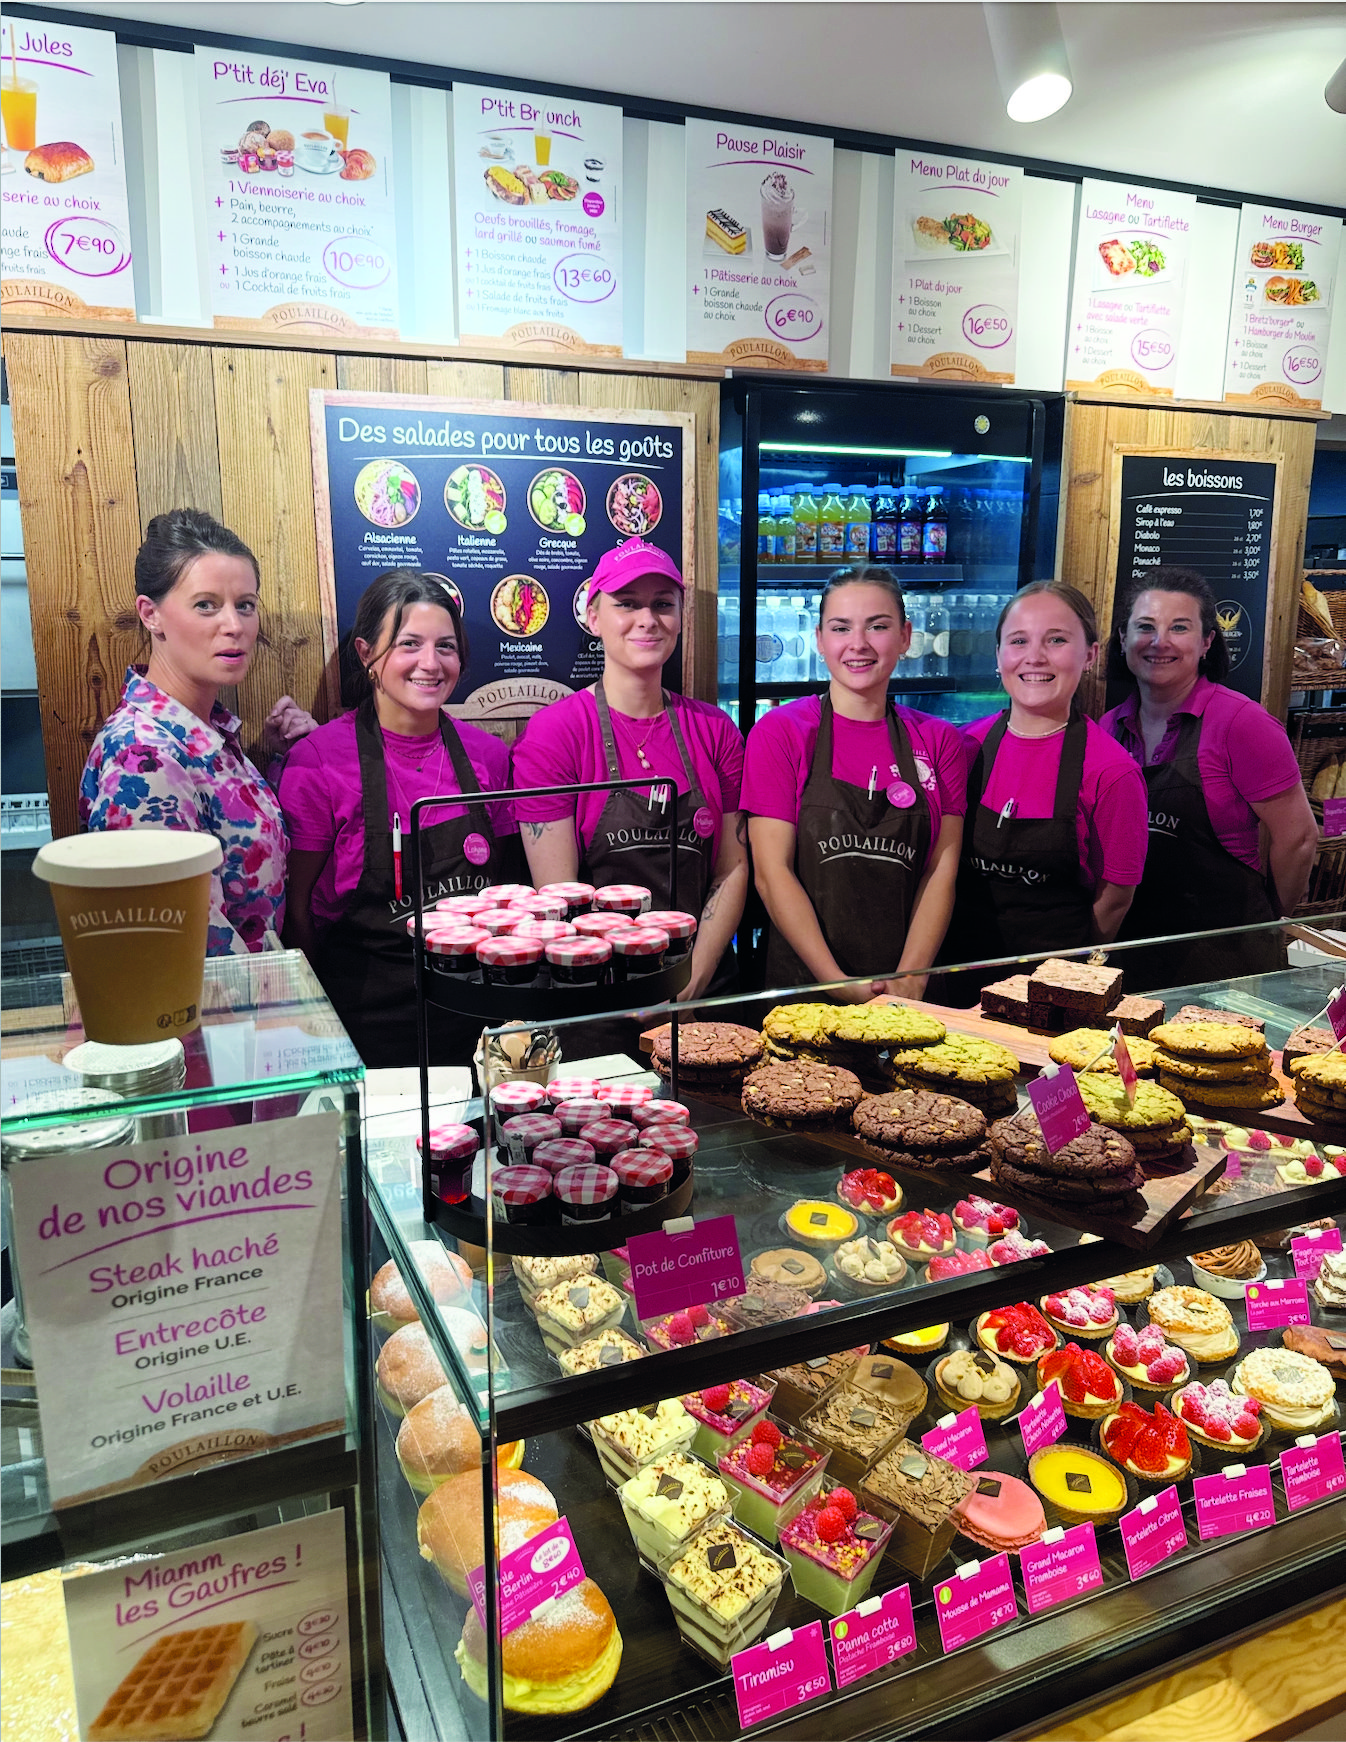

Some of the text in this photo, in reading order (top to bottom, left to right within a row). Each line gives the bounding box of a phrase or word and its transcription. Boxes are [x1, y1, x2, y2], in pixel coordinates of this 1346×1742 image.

[19, 32, 73, 57] Jules
[214, 61, 329, 95] P'tit déj' Eva
[481, 98, 516, 119] P'tit
[717, 133, 806, 160] Pause Plaisir
[911, 159, 1010, 190] Menu Plat du jour
[43, 196, 60, 207] au
[64, 195, 102, 211] choix
[238, 181, 366, 207] Viennoiserie au choix
[1126, 192, 1155, 210] Menu
[230, 198, 296, 218] Pain, beurre,
[1086, 204, 1190, 232] Lasagne ou Tartiflette
[231, 213, 239, 224] 2
[241, 216, 331, 232] accompagnements
[334, 225, 345, 234] au
[474, 212, 597, 238] Oeufs brouillés, fromage,
[1262, 214, 1323, 237] Menu Burger
[60, 233, 115, 255] 7€90
[240, 233, 279, 247] Grande
[474, 226, 601, 251] lard grillé ou saumon fumé
[233, 248, 311, 264] boisson chaude
[330, 251, 385, 272] 10€90
[481, 248, 547, 265] Boisson chaude
[241, 266, 327, 284] Jus d'orange frais
[561, 268, 611, 288] 13€60
[711, 269, 798, 288] Pâtisserie au choix
[243, 281, 285, 294] Cocktail
[287, 283, 299, 294] de
[301, 283, 328, 297] fruits
[330, 287, 351, 300] frais
[710, 287, 740, 299] Grande
[915, 279, 963, 296] Plat du jour
[704, 299, 763, 312] boisson chaude
[914, 296, 942, 308] Boisson
[272, 308, 348, 328] POULAILLON
[715, 311, 736, 321] choix
[775, 309, 814, 327] 6€90
[968, 317, 1008, 335] 16€50
[511, 326, 578, 345] POULAILLON
[913, 323, 942, 335] Dessert
[730, 343, 788, 361] POULAILLON
[1137, 339, 1171, 356] 15€50
[929, 356, 980, 373] POULAILLON
[339, 417, 674, 462] Des salades pour tous les goûts
[1163, 467, 1243, 489] les boissons
[1136, 504, 1153, 514] Café
[1153, 506, 1182, 517] expresso
[1136, 518, 1154, 528] Sirop
[364, 532, 417, 545] Alsacienne
[458, 535, 497, 546] Italienne
[539, 537, 577, 551] Grecque
[1134, 531, 1160, 540] Diabolo
[1134, 544, 1160, 553] Monaco
[1133, 557, 1161, 566] Panaché
[500, 641, 543, 653] Mexicaine
[605, 828, 705, 847] POULAILON
[818, 834, 917, 861] POULAILLON
[388, 875, 493, 914] POLAILLON
[70, 907, 187, 930] POULAILLON
[1036, 1094, 1058, 1115] Cookie
[104, 1144, 249, 1190] Origine
[38, 1165, 313, 1241] de nos viandes
[89, 1232, 280, 1293] Steak haché
[634, 1246, 735, 1279] Pot de Confiture
[111, 1266, 263, 1309] Origine France
[711, 1276, 740, 1298] 1€10
[115, 1304, 267, 1356] Entrecôte
[135, 1332, 251, 1370] Origine U.E.
[142, 1372, 251, 1414] Volaille
[90, 1383, 302, 1449] Origine France et U.E.
[148, 1434, 260, 1474] POULAILLON
[1286, 1457, 1318, 1476] Tartelette
[1287, 1468, 1321, 1488] Framboise
[1326, 1475, 1345, 1491] 4€10
[1199, 1486, 1268, 1509] Tartelette Fraises
[1126, 1508, 1180, 1547] Tartelette Citron
[1246, 1509, 1271, 1526] 4€20
[1027, 1543, 1086, 1573] Grand Macaron
[124, 1553, 225, 1598] Miamm
[502, 1572, 533, 1598] Berlin
[551, 1566, 580, 1597] 2€40
[1029, 1564, 1068, 1587] Framboise
[1076, 1569, 1100, 1590] 3€60
[116, 1599, 159, 1627] les
[168, 1554, 287, 1609] Gaufres
[941, 1600, 969, 1622] Mousse
[970, 1595, 979, 1608] de
[990, 1602, 1014, 1625] 3€70
[263, 1628, 294, 1642] Sucre
[836, 1617, 899, 1656] Panna cotta
[886, 1635, 913, 1659] 3€80
[264, 1675, 296, 1692] Fraise
[738, 1658, 795, 1691] Tiramisu
[797, 1676, 826, 1700] 3€50
